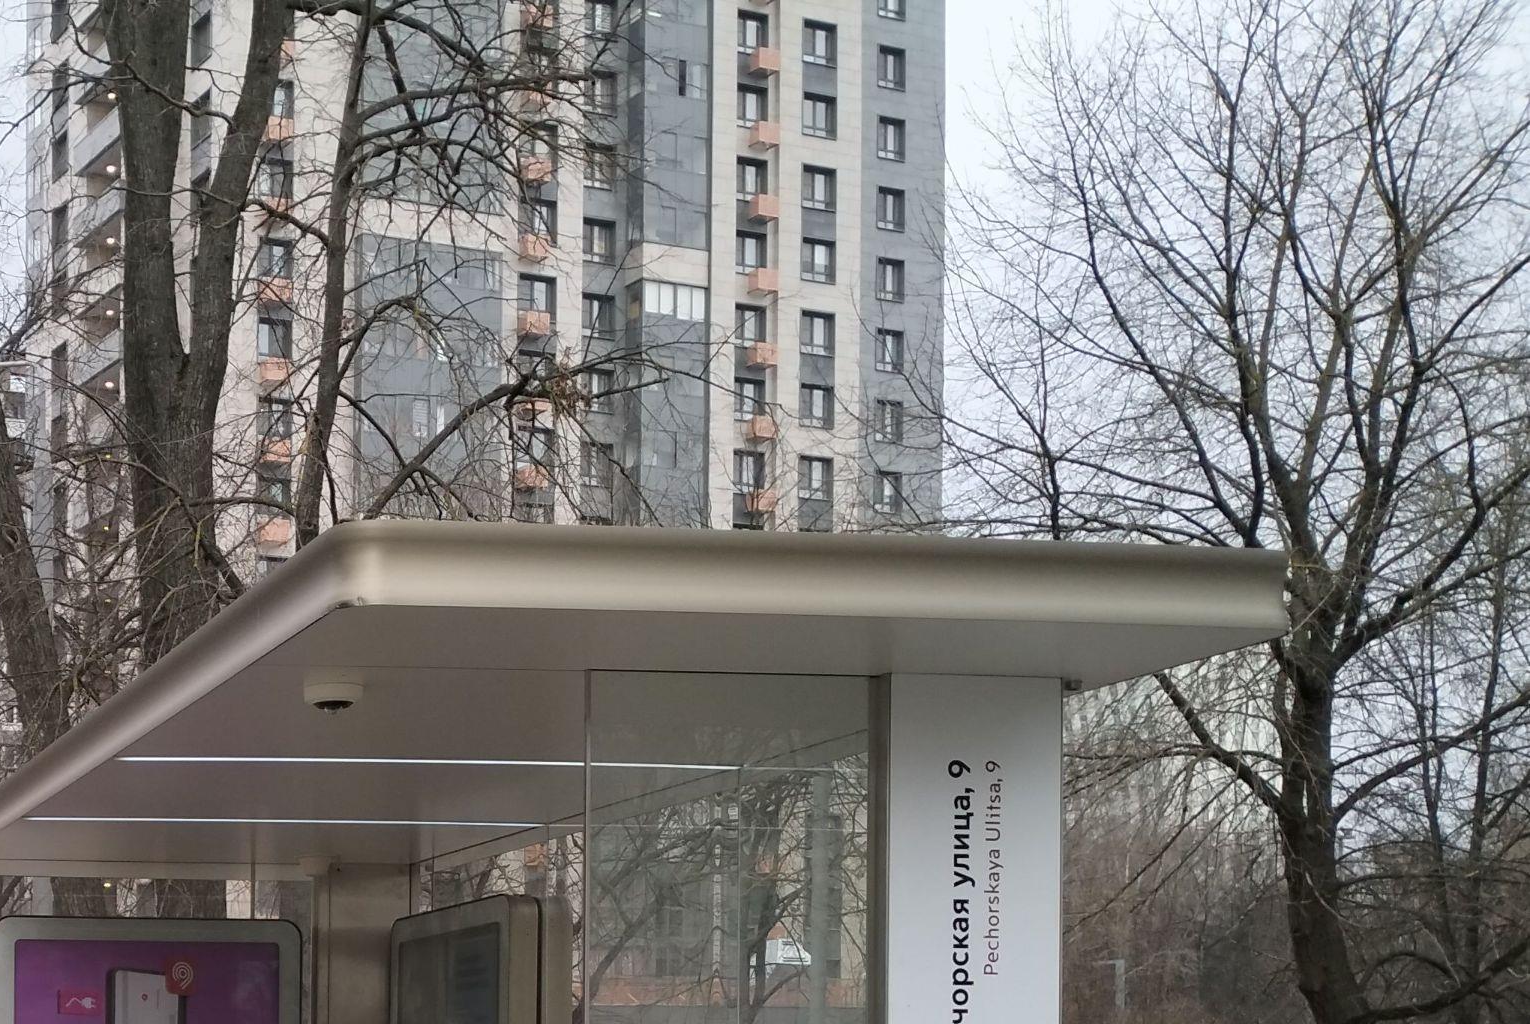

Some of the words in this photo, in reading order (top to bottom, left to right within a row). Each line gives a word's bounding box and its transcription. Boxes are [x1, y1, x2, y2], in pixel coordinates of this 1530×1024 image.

[948, 759, 972, 778] 9
[985, 760, 1001, 773] 9
[953, 787, 975, 887] улица,
[985, 778, 1003, 842] Ulitsa,
[983, 849, 1004, 976] Pechorskaya
